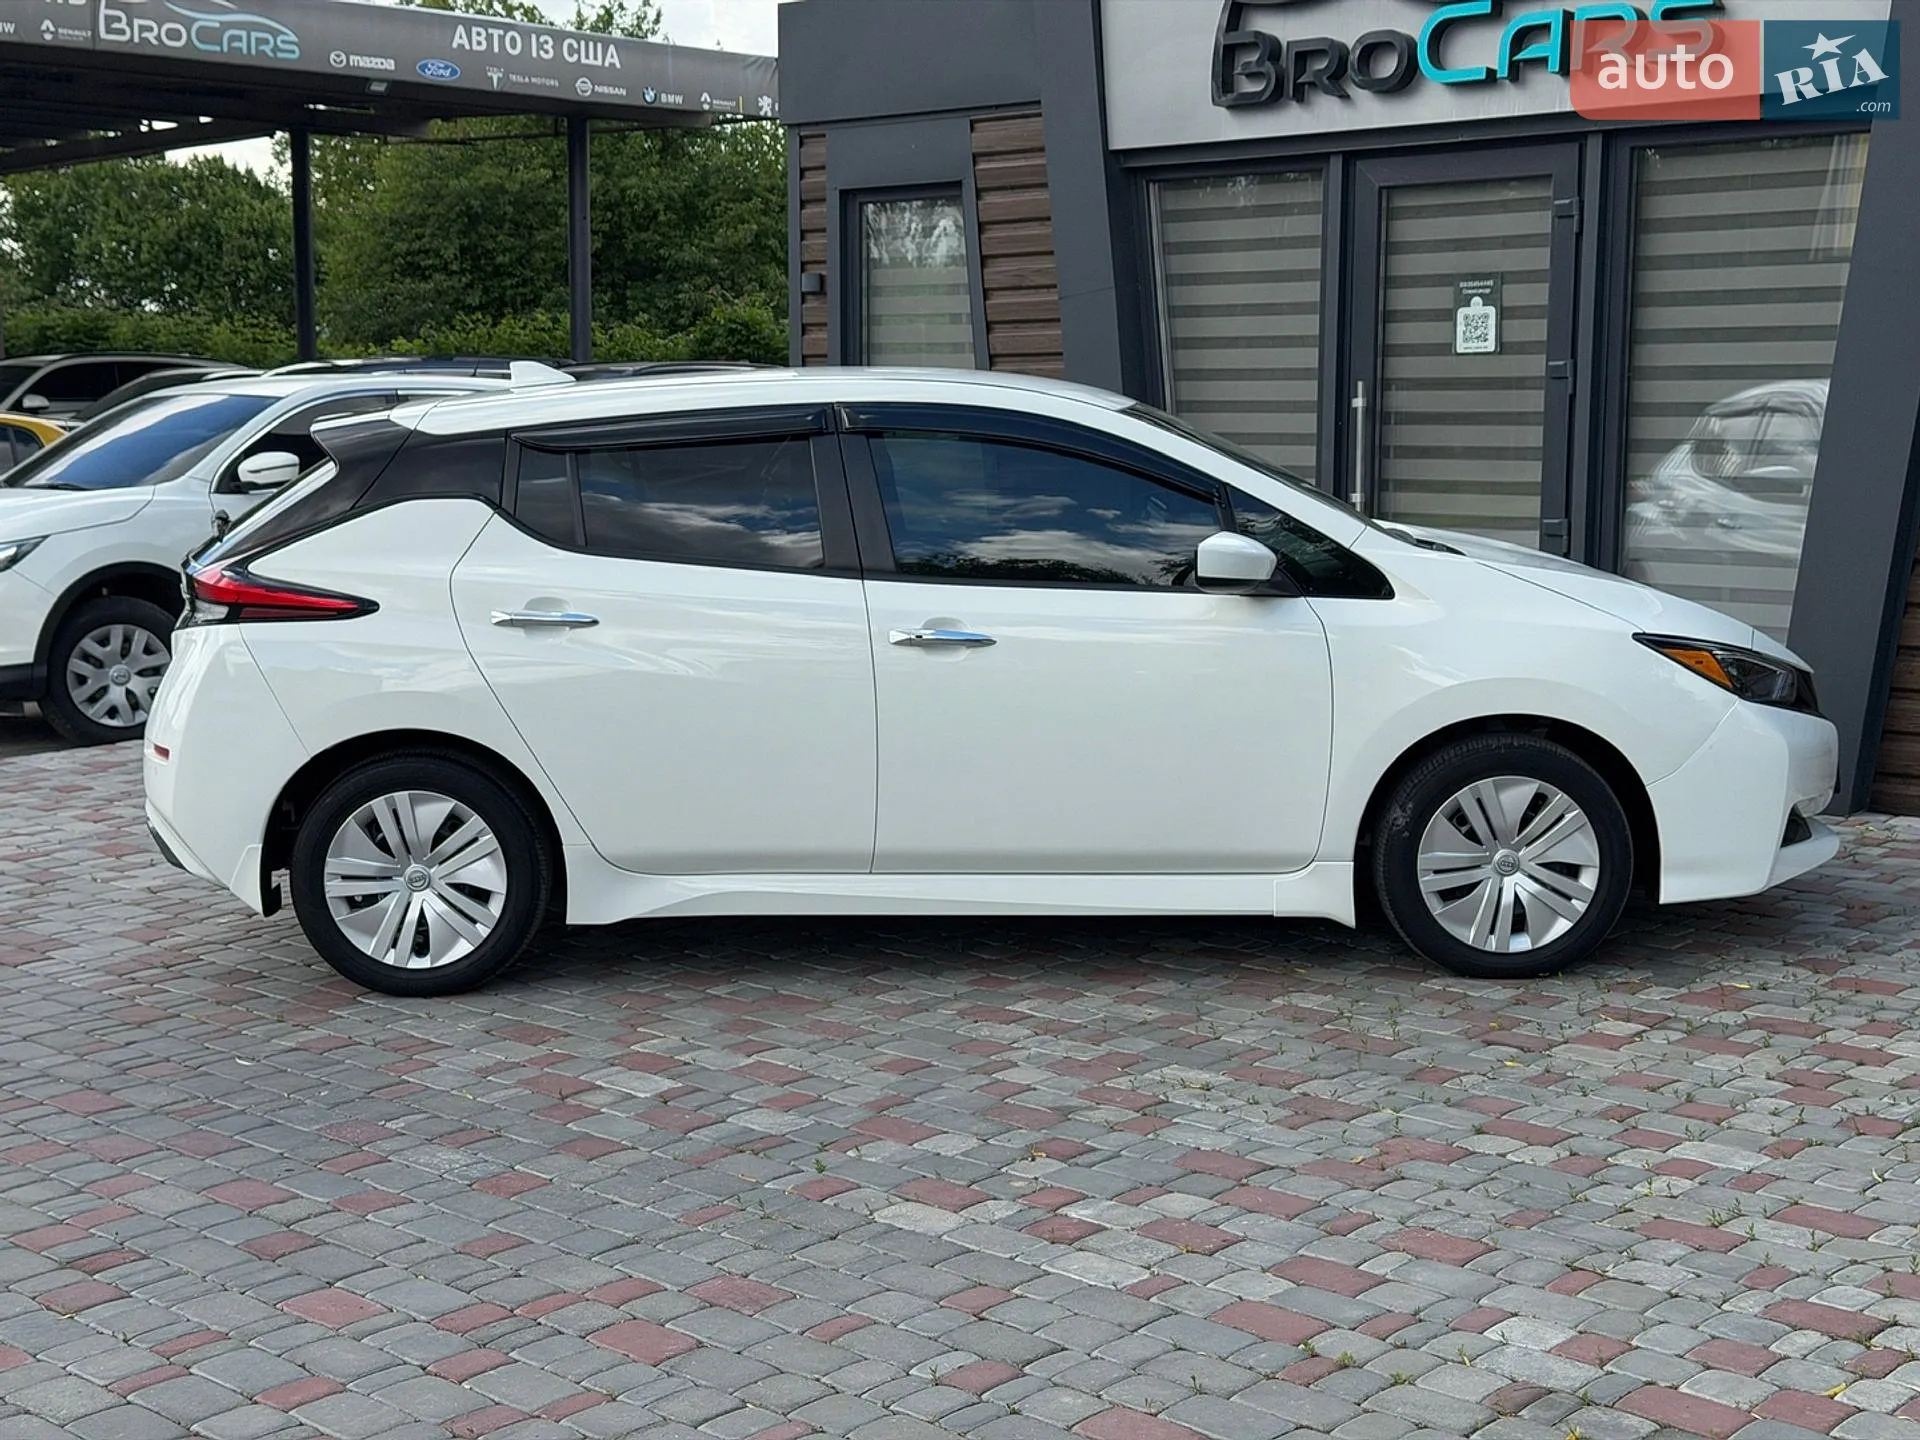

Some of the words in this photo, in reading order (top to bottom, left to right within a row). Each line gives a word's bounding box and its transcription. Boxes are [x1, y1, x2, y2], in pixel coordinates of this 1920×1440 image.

[452, 24, 522, 55] АВТО
[562, 37, 621, 69] США
[424, 62, 452, 77] Ford
[594, 84, 627, 97] NISSAN
[660, 93, 684, 105] BMW
